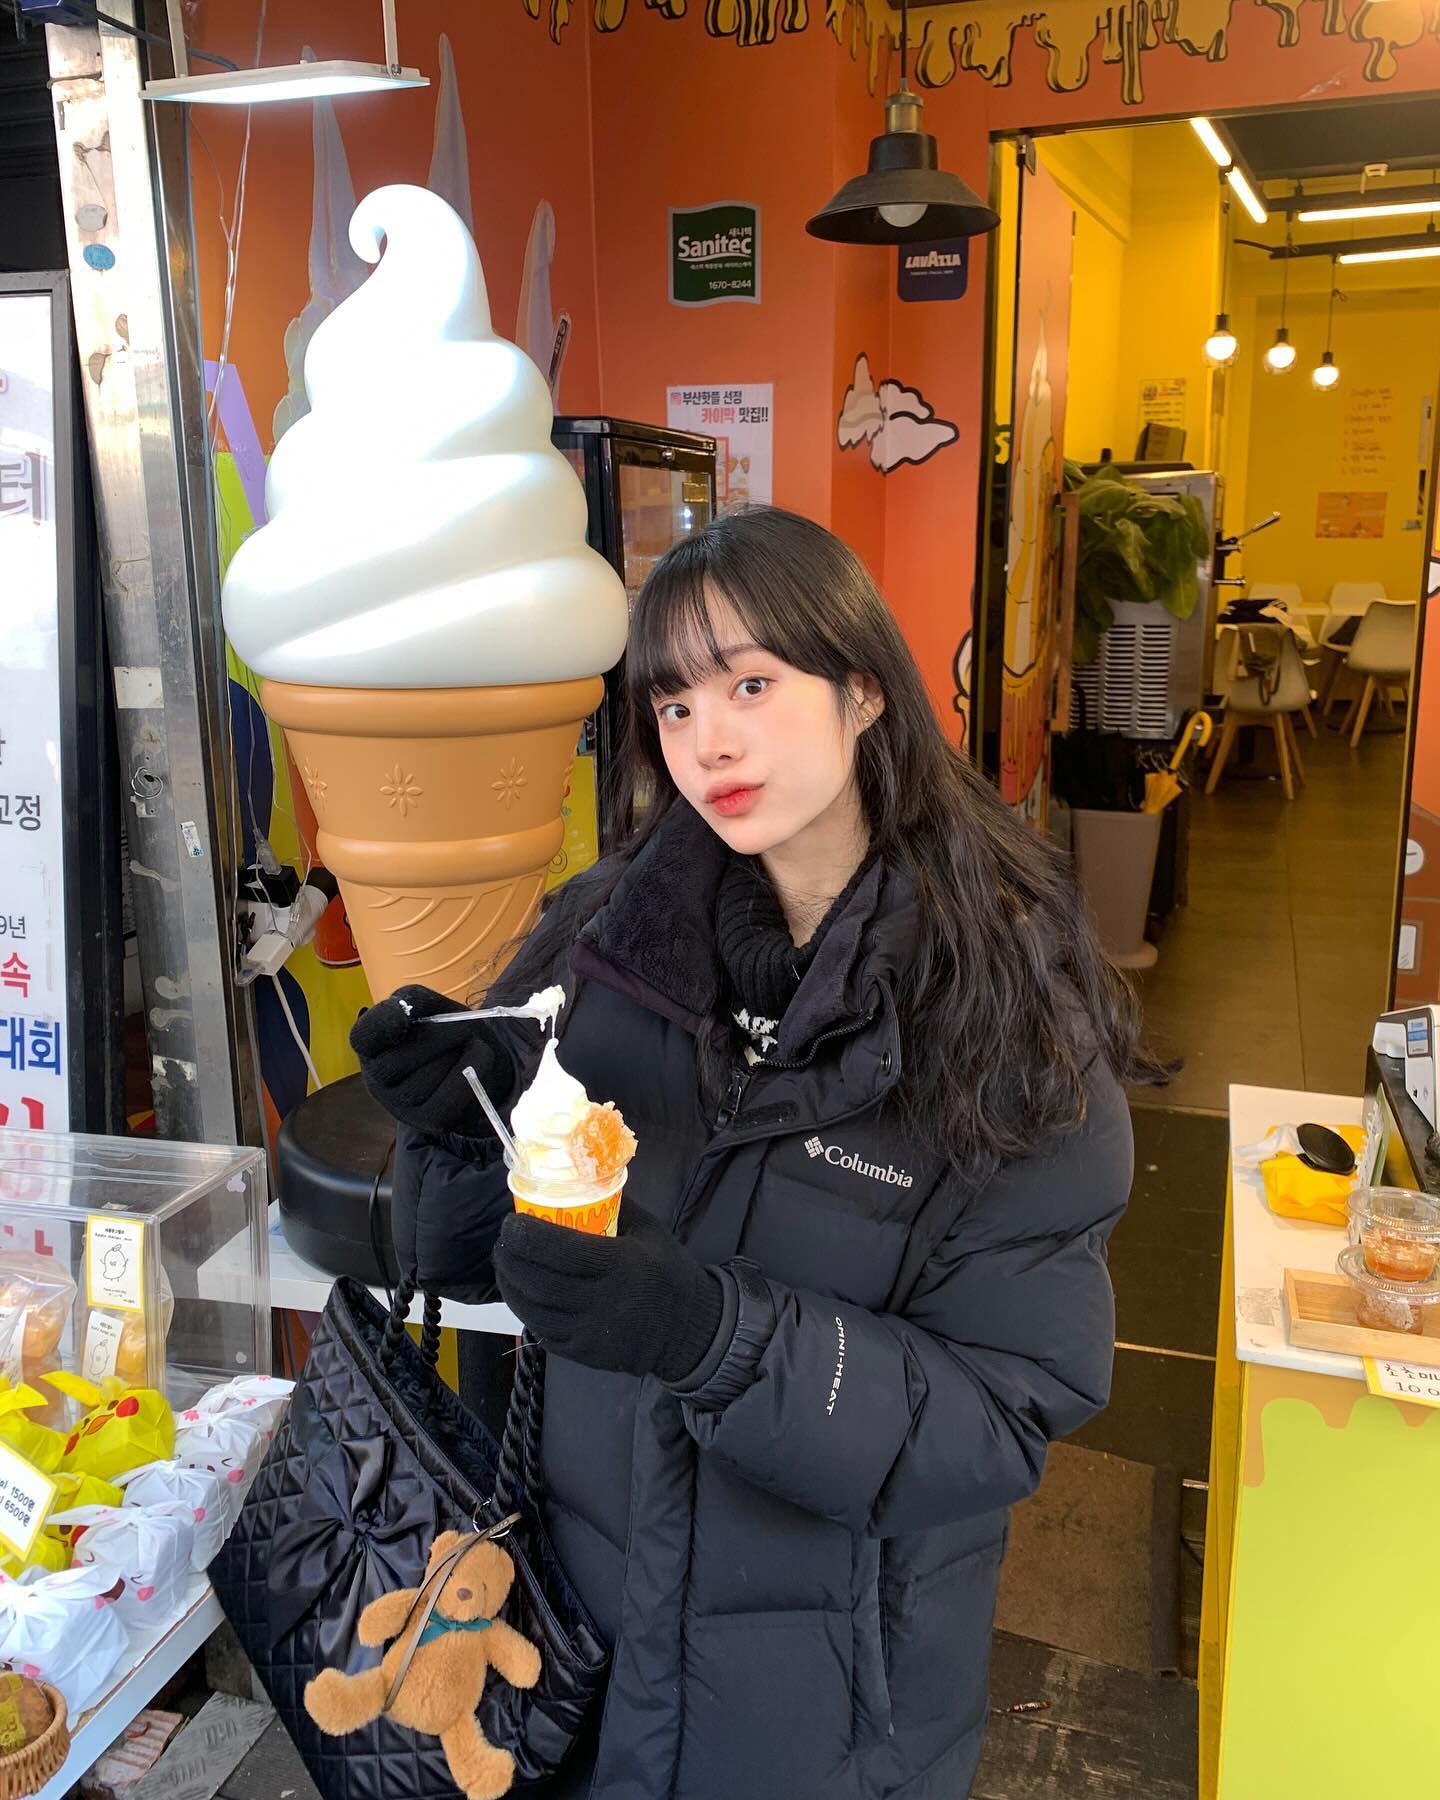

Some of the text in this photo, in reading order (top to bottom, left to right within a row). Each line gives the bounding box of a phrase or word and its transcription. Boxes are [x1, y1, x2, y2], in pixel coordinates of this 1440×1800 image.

[678, 233, 752, 258] Sanitec
[905, 251, 962, 269] LAVAZZA
[709, 280, 752, 290] 1670-8244
[682, 390, 743, 406] 부산핫플 선정
[701, 406, 769, 424] 카이막 맛집!!
[0, 951, 31, 998] 속
[0, 1016, 61, 1076] 대회
[824, 1145, 913, 1188] Columbia
[826, 1316, 845, 1416] OMNI-HEAT
[10, 1486, 36, 1513] 1500원
[4, 1499, 31, 1528] 6500원
